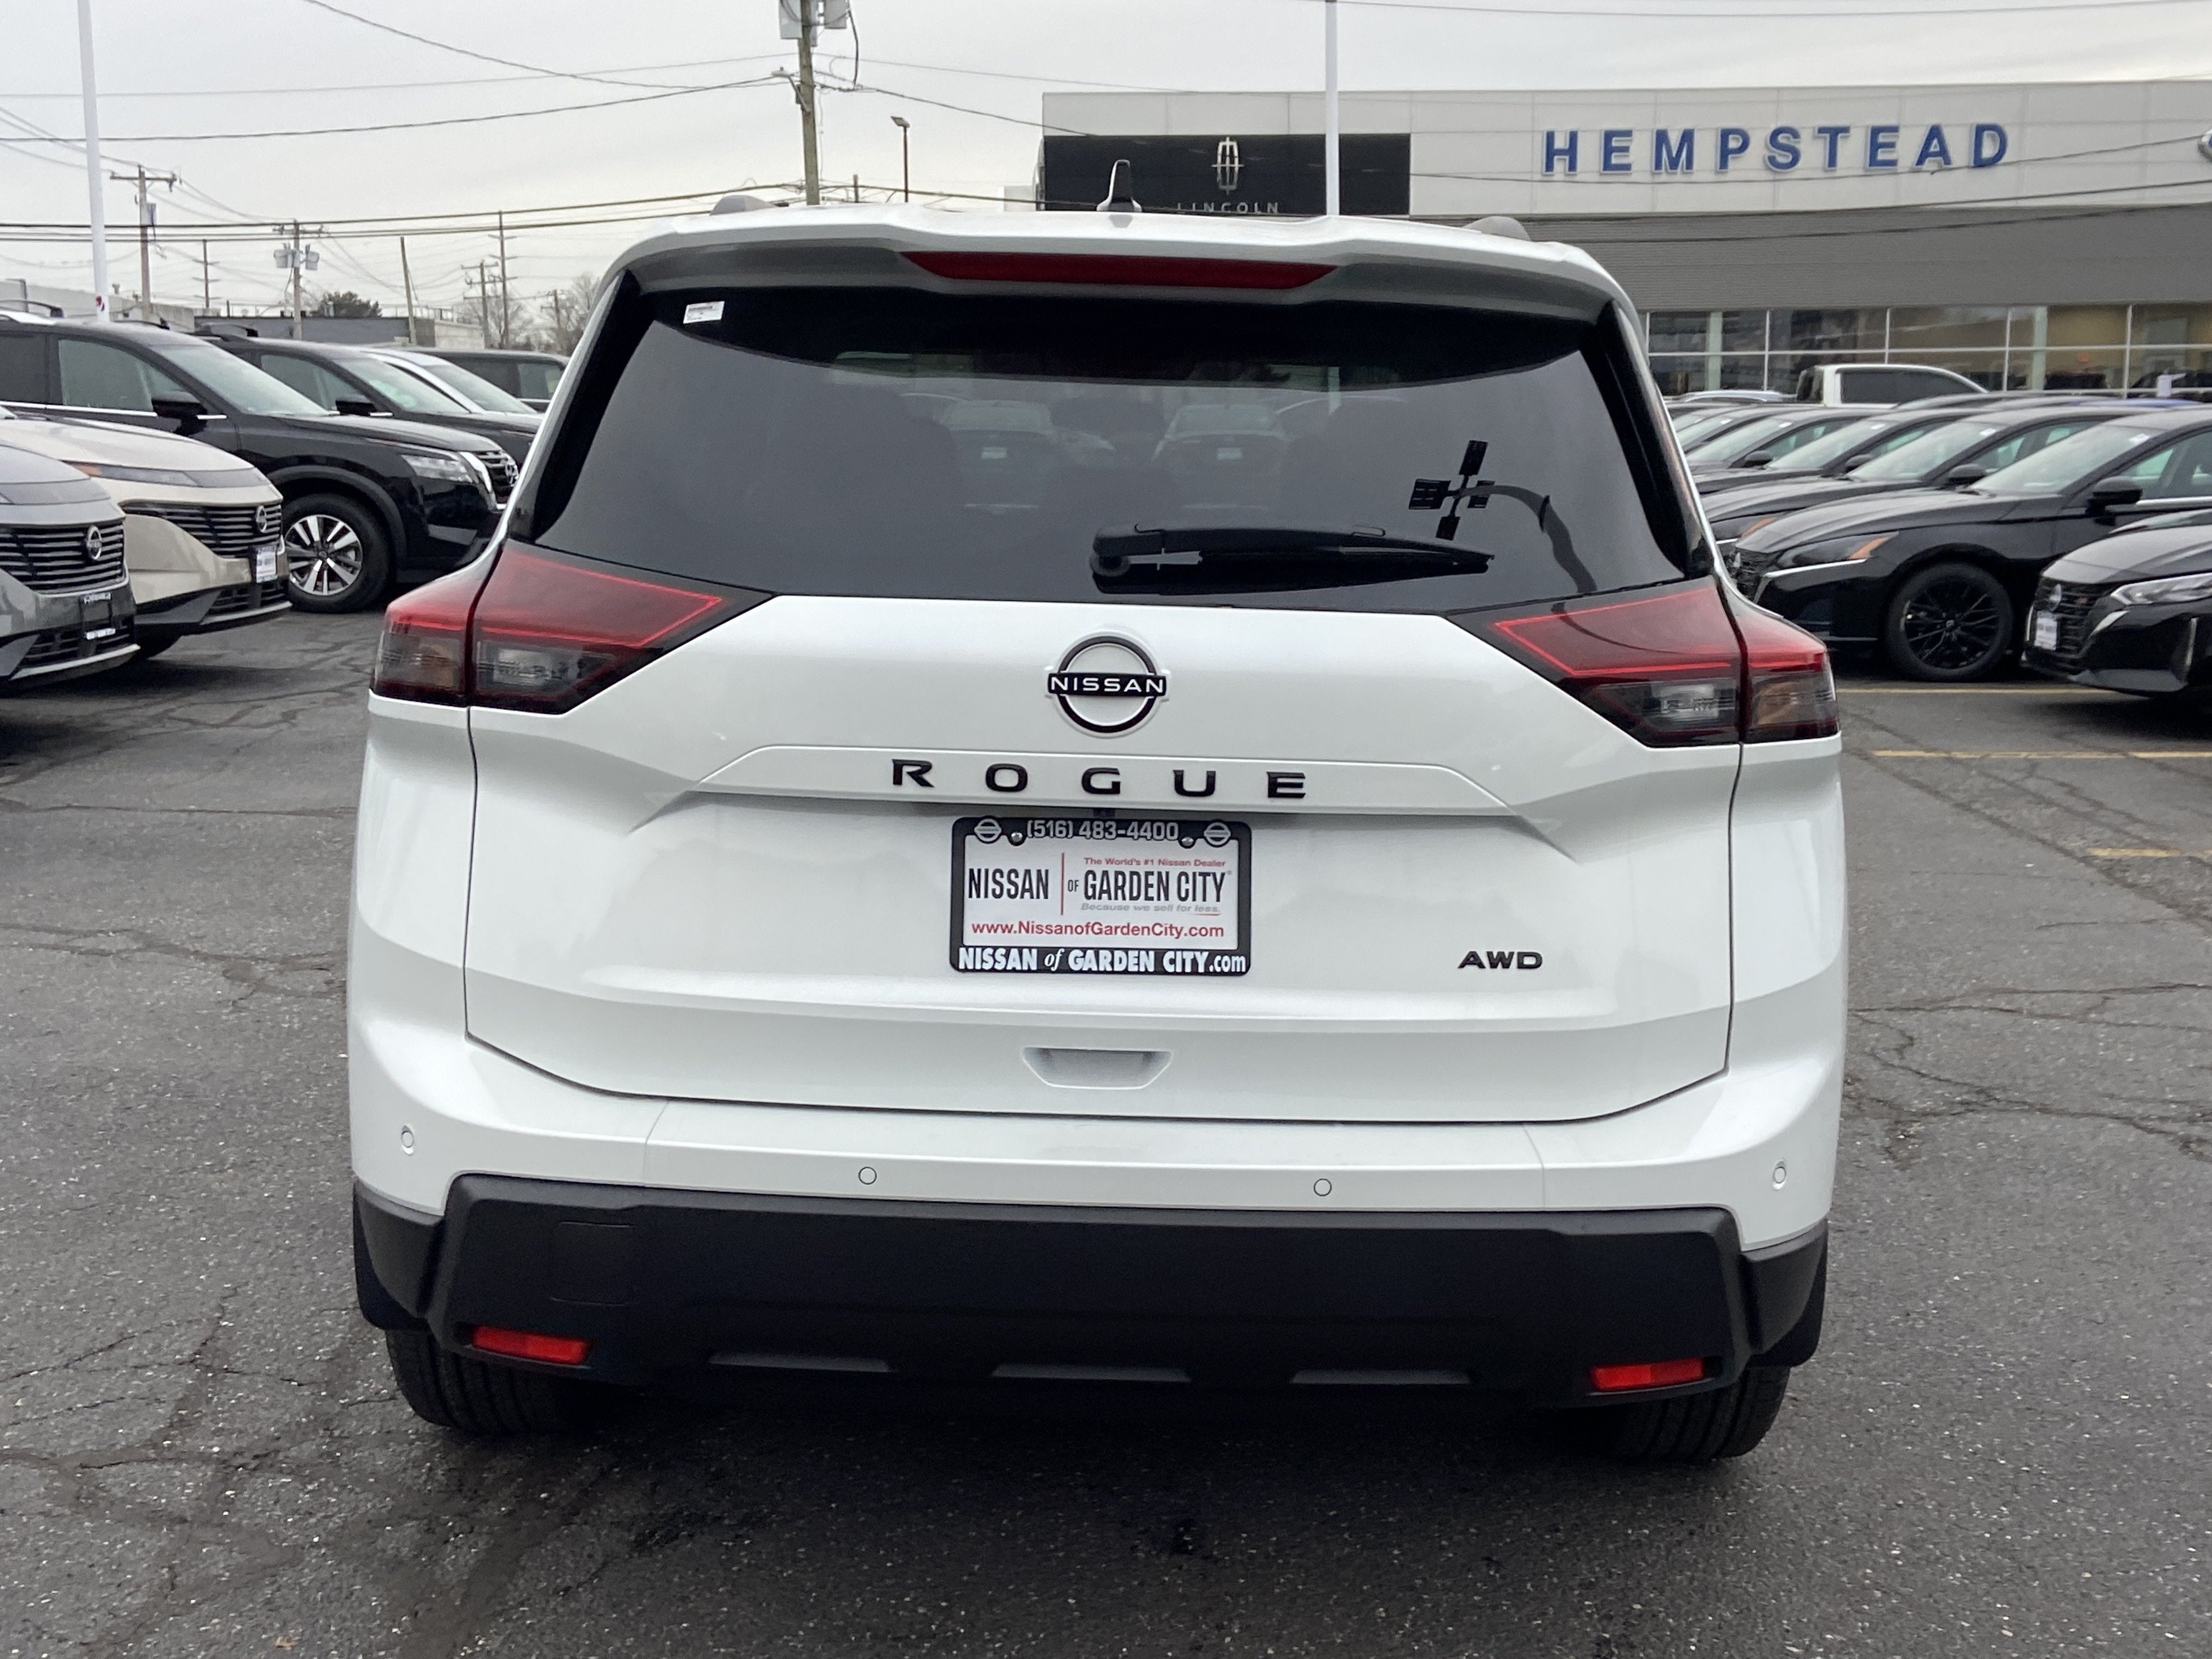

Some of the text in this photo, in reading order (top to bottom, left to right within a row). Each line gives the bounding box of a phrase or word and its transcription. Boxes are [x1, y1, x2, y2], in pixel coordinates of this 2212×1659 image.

[1543, 123, 2008, 174] HEMPSTEAD
[1051, 676, 1163, 693] NISSAN
[891, 758, 1307, 799] ROGUE
[1027, 820, 1178, 840] (516) 483-4400
[1105, 857, 1141, 866] World's
[968, 868, 1226, 902] NISSAN OF GARDEN CITY
[1081, 902, 1130, 911] Because
[1176, 904, 1192, 912] for
[972, 921, 1224, 939] www.NissanofGardenCity.com
[959, 947, 1246, 973] NISSAN of GARDEN CITY.com
[1457, 951, 1543, 969] AWD
